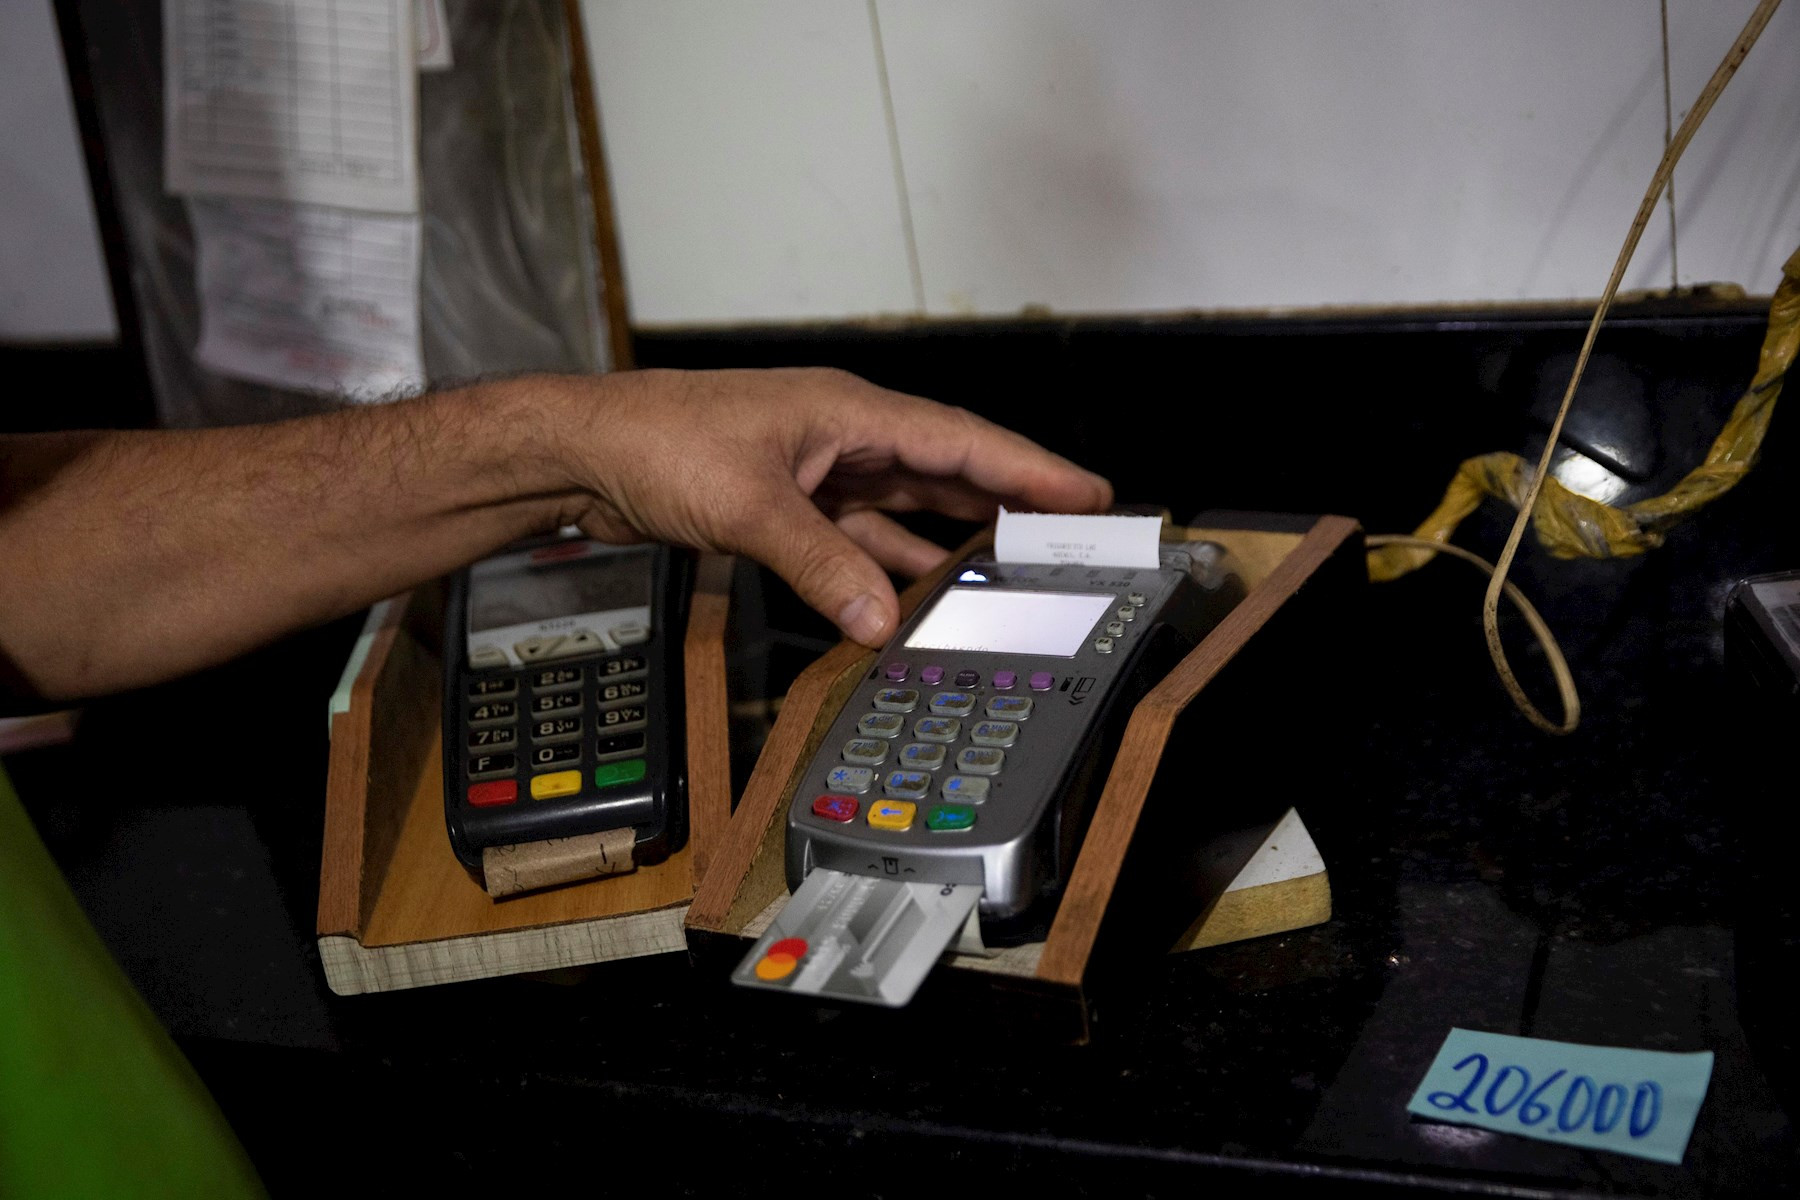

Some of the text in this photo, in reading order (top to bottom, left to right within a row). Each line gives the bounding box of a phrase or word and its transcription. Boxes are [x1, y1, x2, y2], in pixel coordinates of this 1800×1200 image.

[607, 661, 621, 674] 3
[540, 671, 555, 685] 2
[476, 680, 486, 694] 1
[604, 687, 618, 700] 6
[540, 697, 554, 710] 5
[475, 705, 489, 719] 4
[605, 711, 620, 724] 9
[864, 715, 877, 726] 4
[540, 721, 554, 735] 8
[978, 724, 990, 735] 6
[478, 731, 490, 744] 7
[851, 742, 863, 752] 7
[965, 750, 977, 763] 9
[478, 756, 491, 771] F
[891, 773, 904, 787] 0
